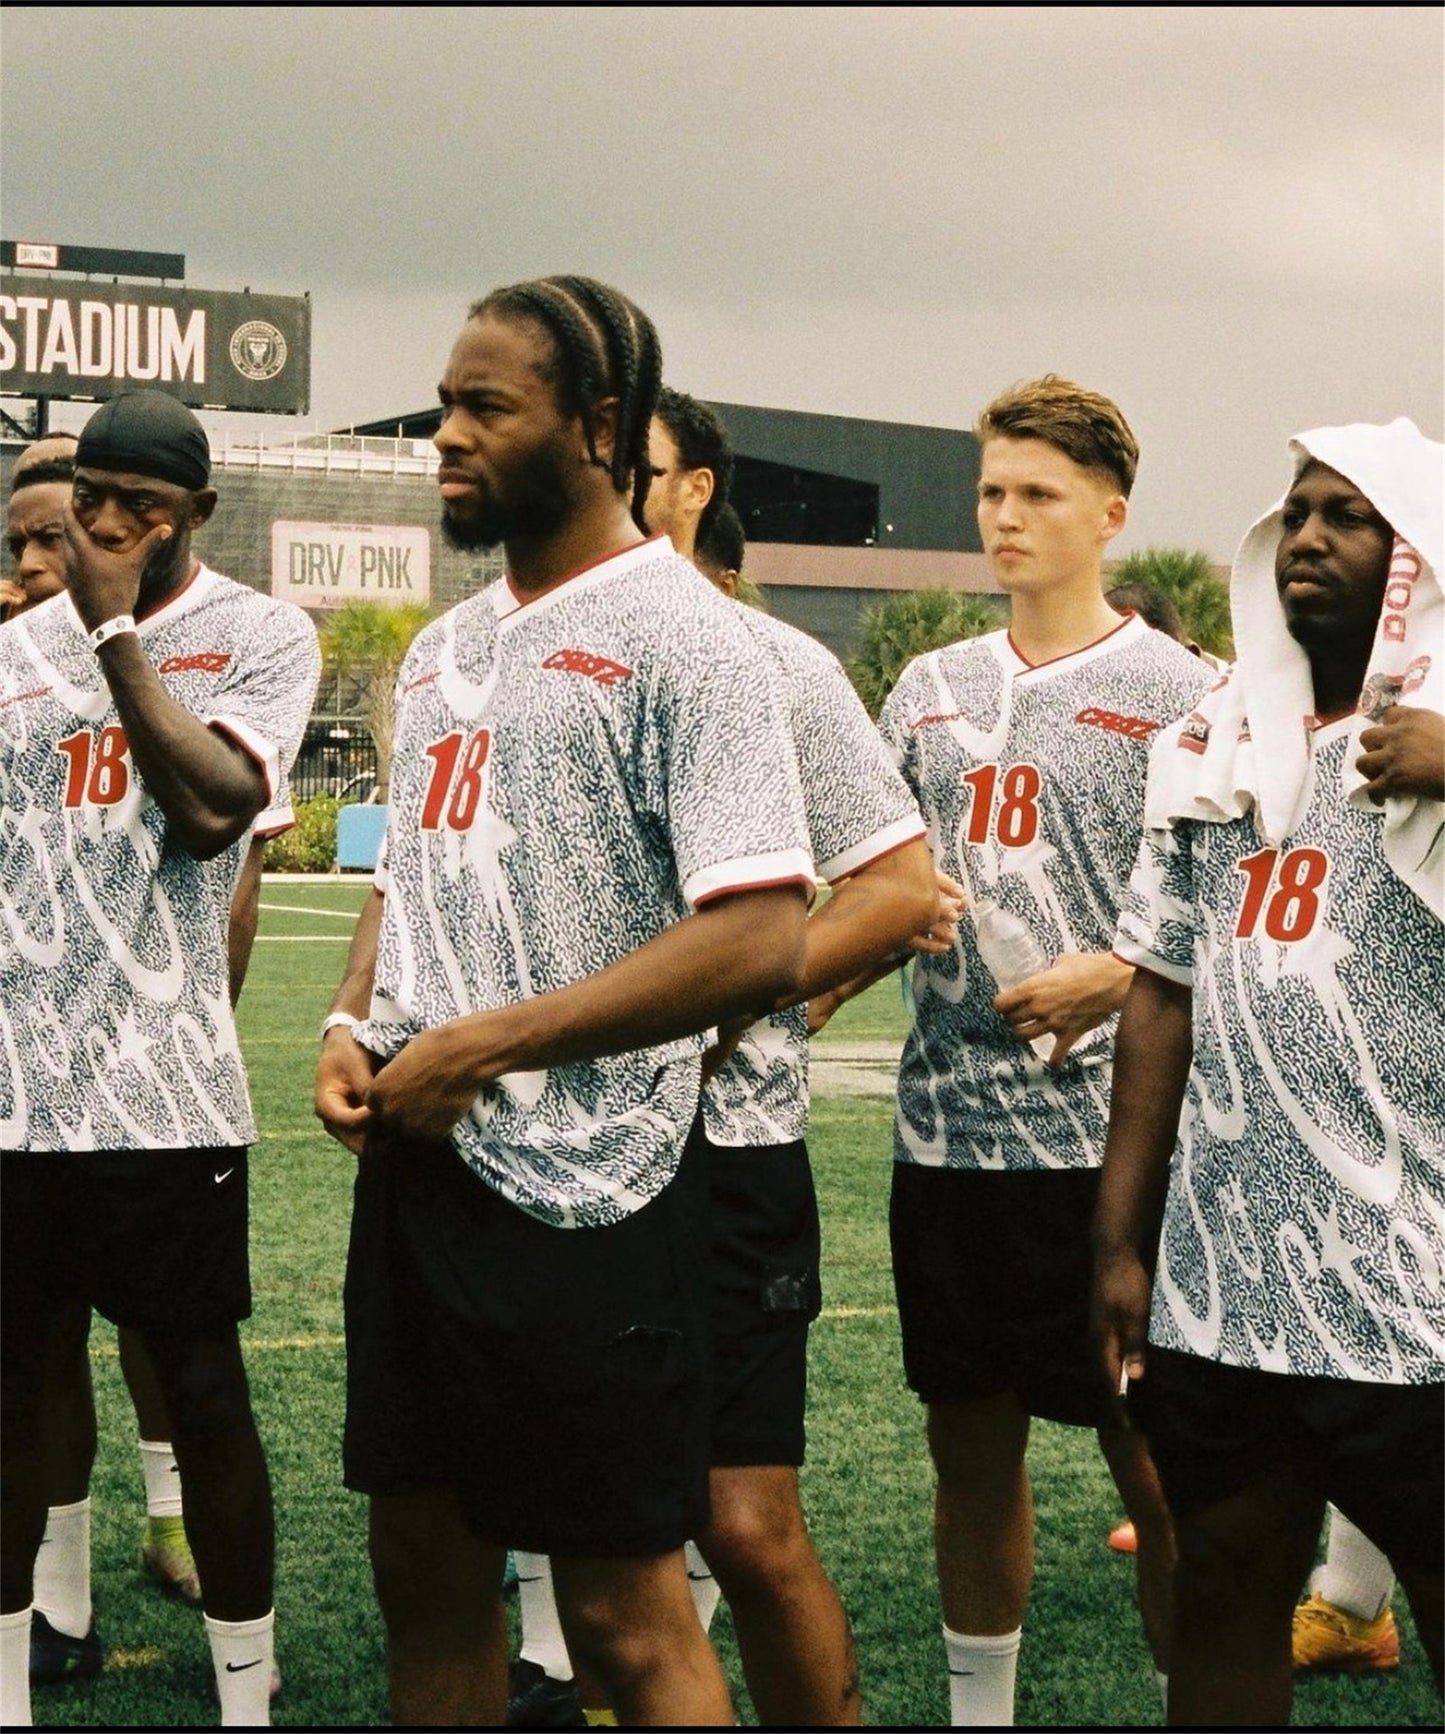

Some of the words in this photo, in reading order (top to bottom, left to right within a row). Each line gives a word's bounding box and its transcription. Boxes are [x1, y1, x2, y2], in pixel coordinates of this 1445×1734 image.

[289, 542, 345, 586] DRV
[360, 545, 413, 590] PNK
[57, 725, 129, 808] 18
[421, 729, 491, 832] 18
[962, 764, 1041, 848] 18
[1235, 847, 1328, 942] 18
